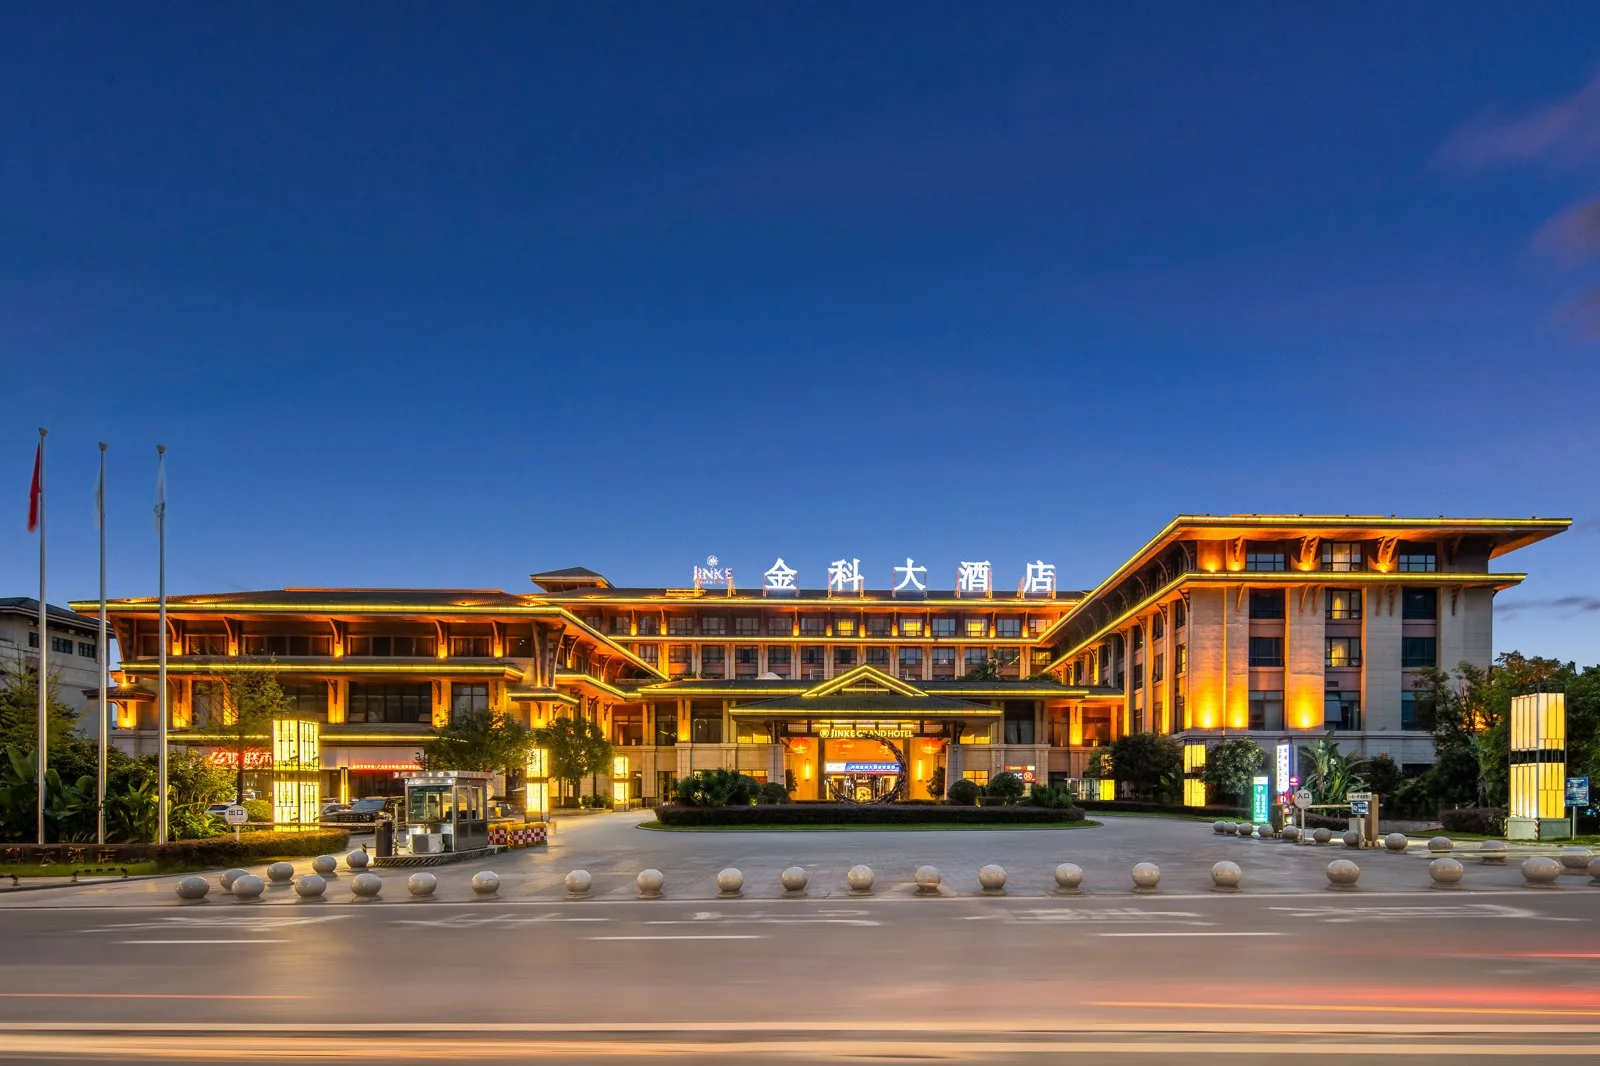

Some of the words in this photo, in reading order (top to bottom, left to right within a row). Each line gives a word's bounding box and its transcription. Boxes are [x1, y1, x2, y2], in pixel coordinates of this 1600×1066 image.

[764, 557, 1056, 592] 金科大酒店
[830, 728, 856, 738] JINKE
[888, 729, 914, 738] HOTEL
